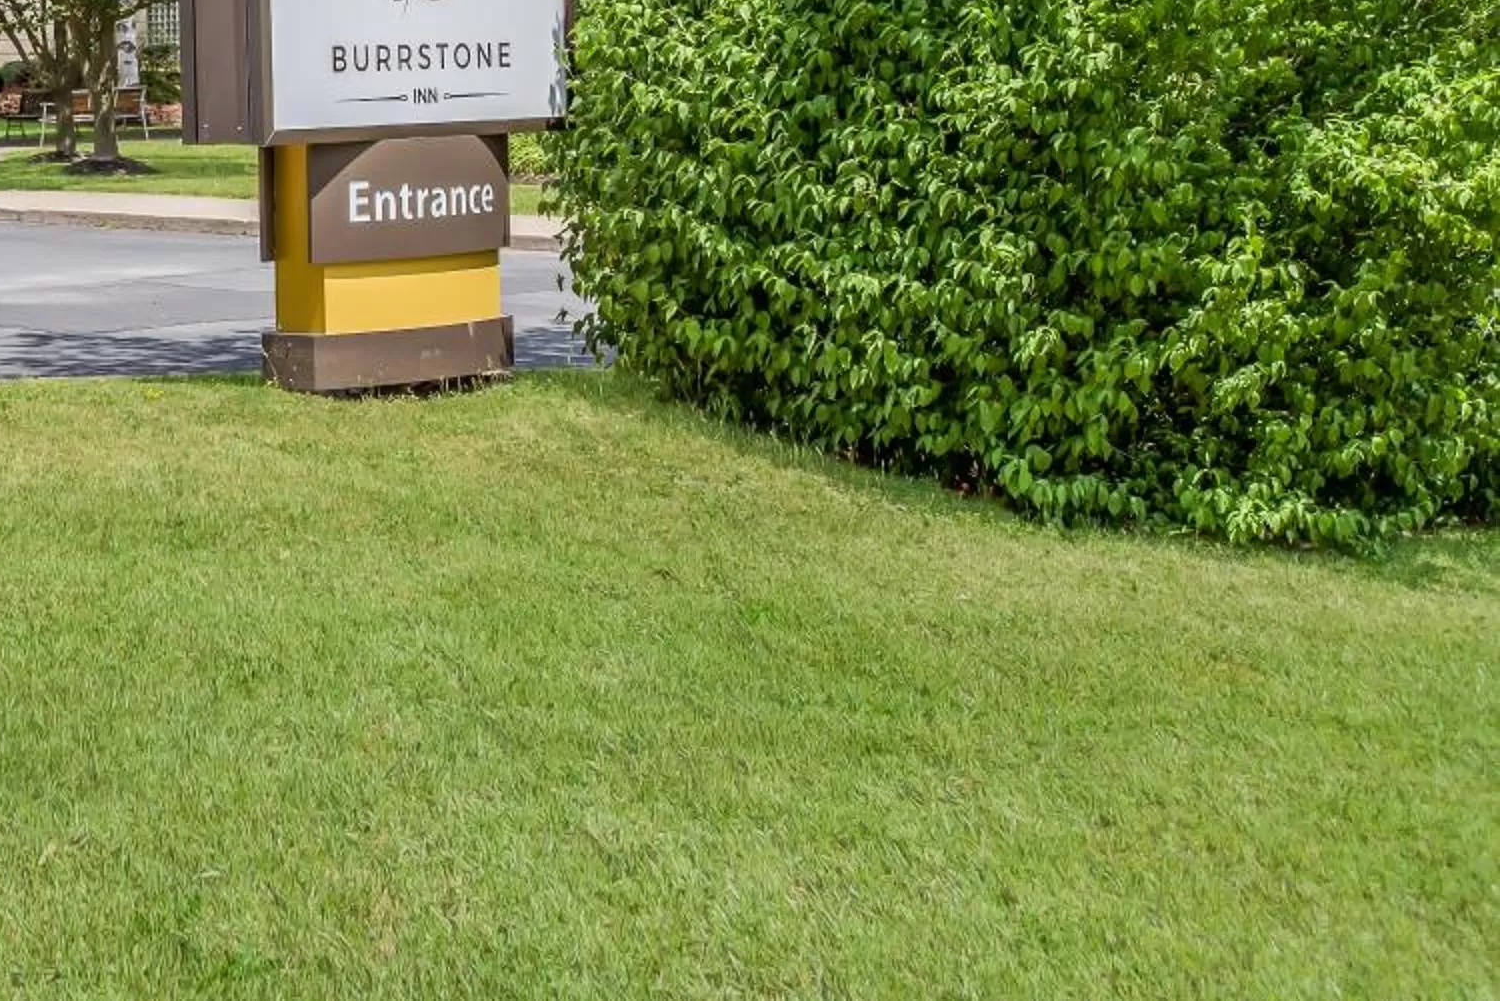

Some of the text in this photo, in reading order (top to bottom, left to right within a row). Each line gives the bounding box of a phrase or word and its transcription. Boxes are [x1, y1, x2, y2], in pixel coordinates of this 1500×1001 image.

[331, 42, 512, 74] BURRSTONE
[413, 87, 439, 104] INN
[348, 180, 494, 223] Entrance
